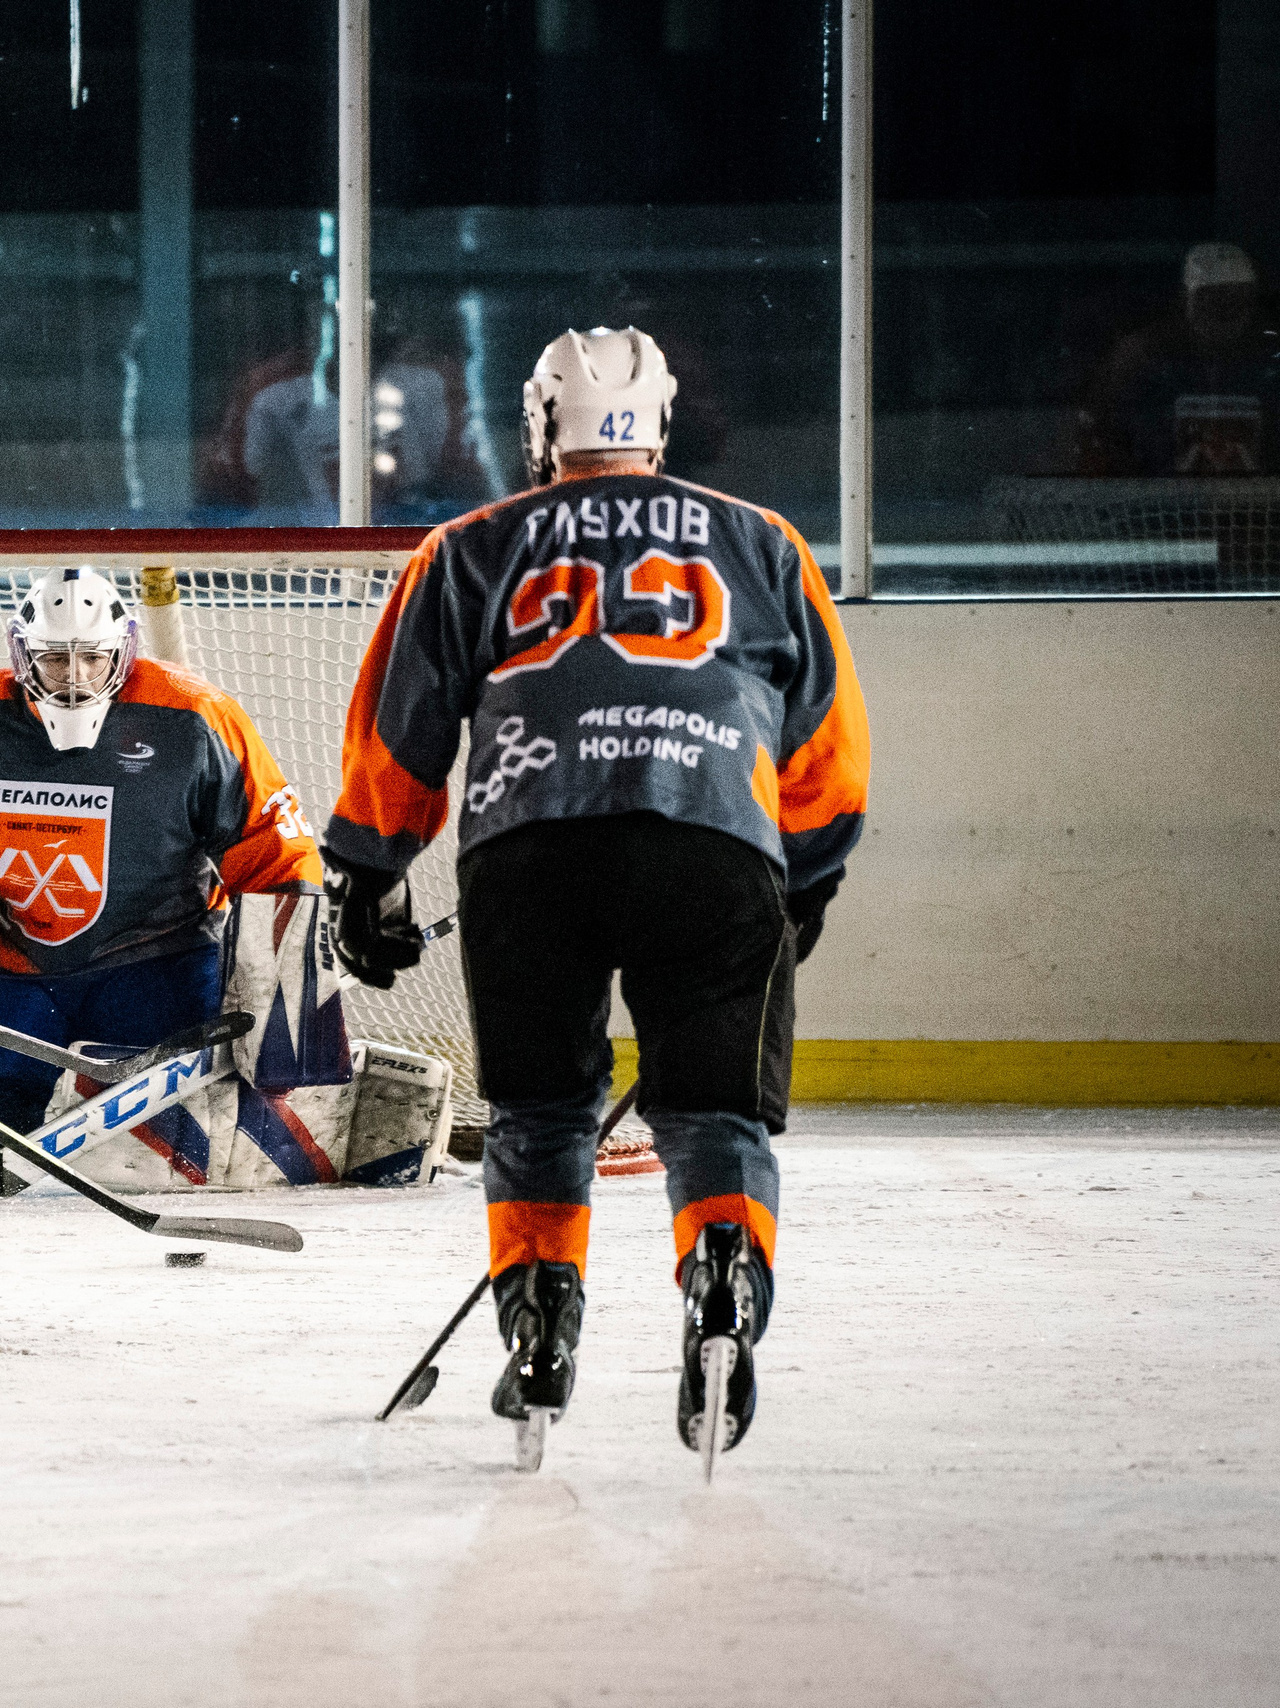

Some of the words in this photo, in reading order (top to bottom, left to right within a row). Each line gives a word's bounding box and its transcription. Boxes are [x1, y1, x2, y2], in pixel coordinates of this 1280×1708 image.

[599, 411, 635, 442] 42
[526, 495, 710, 546] ГЛУХОВ
[578, 705, 742, 750] MEGAPOLIS
[579, 736, 704, 768] HOLDING
[36, 1047, 214, 1159] CCM
